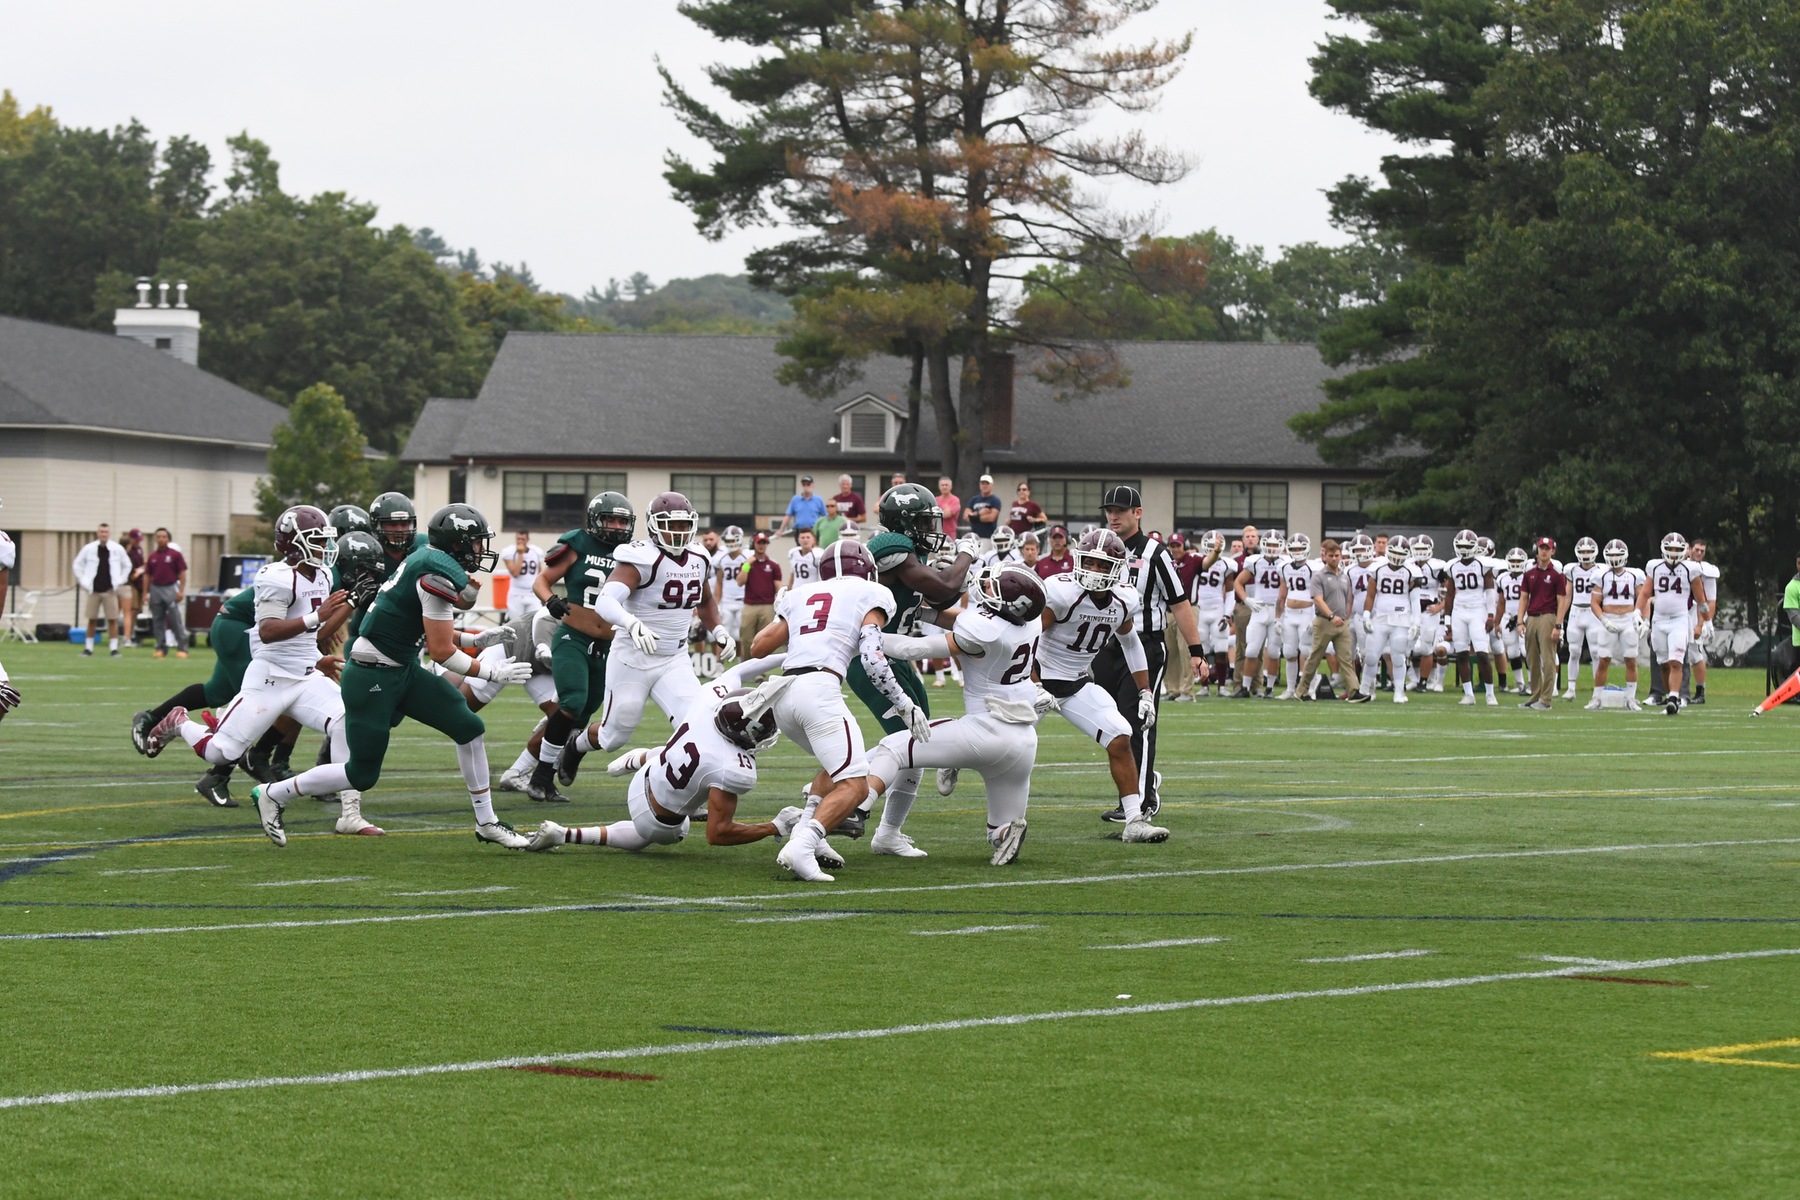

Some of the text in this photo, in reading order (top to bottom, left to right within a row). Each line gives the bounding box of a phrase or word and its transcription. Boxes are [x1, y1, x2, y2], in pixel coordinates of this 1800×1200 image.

[794, 563, 810, 579] 16
[1260, 570, 1281, 589] 49
[1380, 577, 1405, 595] 68
[1455, 572, 1479, 591] 30
[1576, 577, 1594, 594] 82
[1607, 580, 1631, 600] 44
[1658, 576, 1683, 595] 94
[658, 579, 702, 610] 92
[1505, 584, 1521, 601] 19
[799, 592, 834, 636] 3
[1078, 613, 1118, 624] SPRINGFIELD
[1065, 621, 1112, 654] 10
[659, 722, 701, 790] 13
[737, 752, 754, 770] 13
